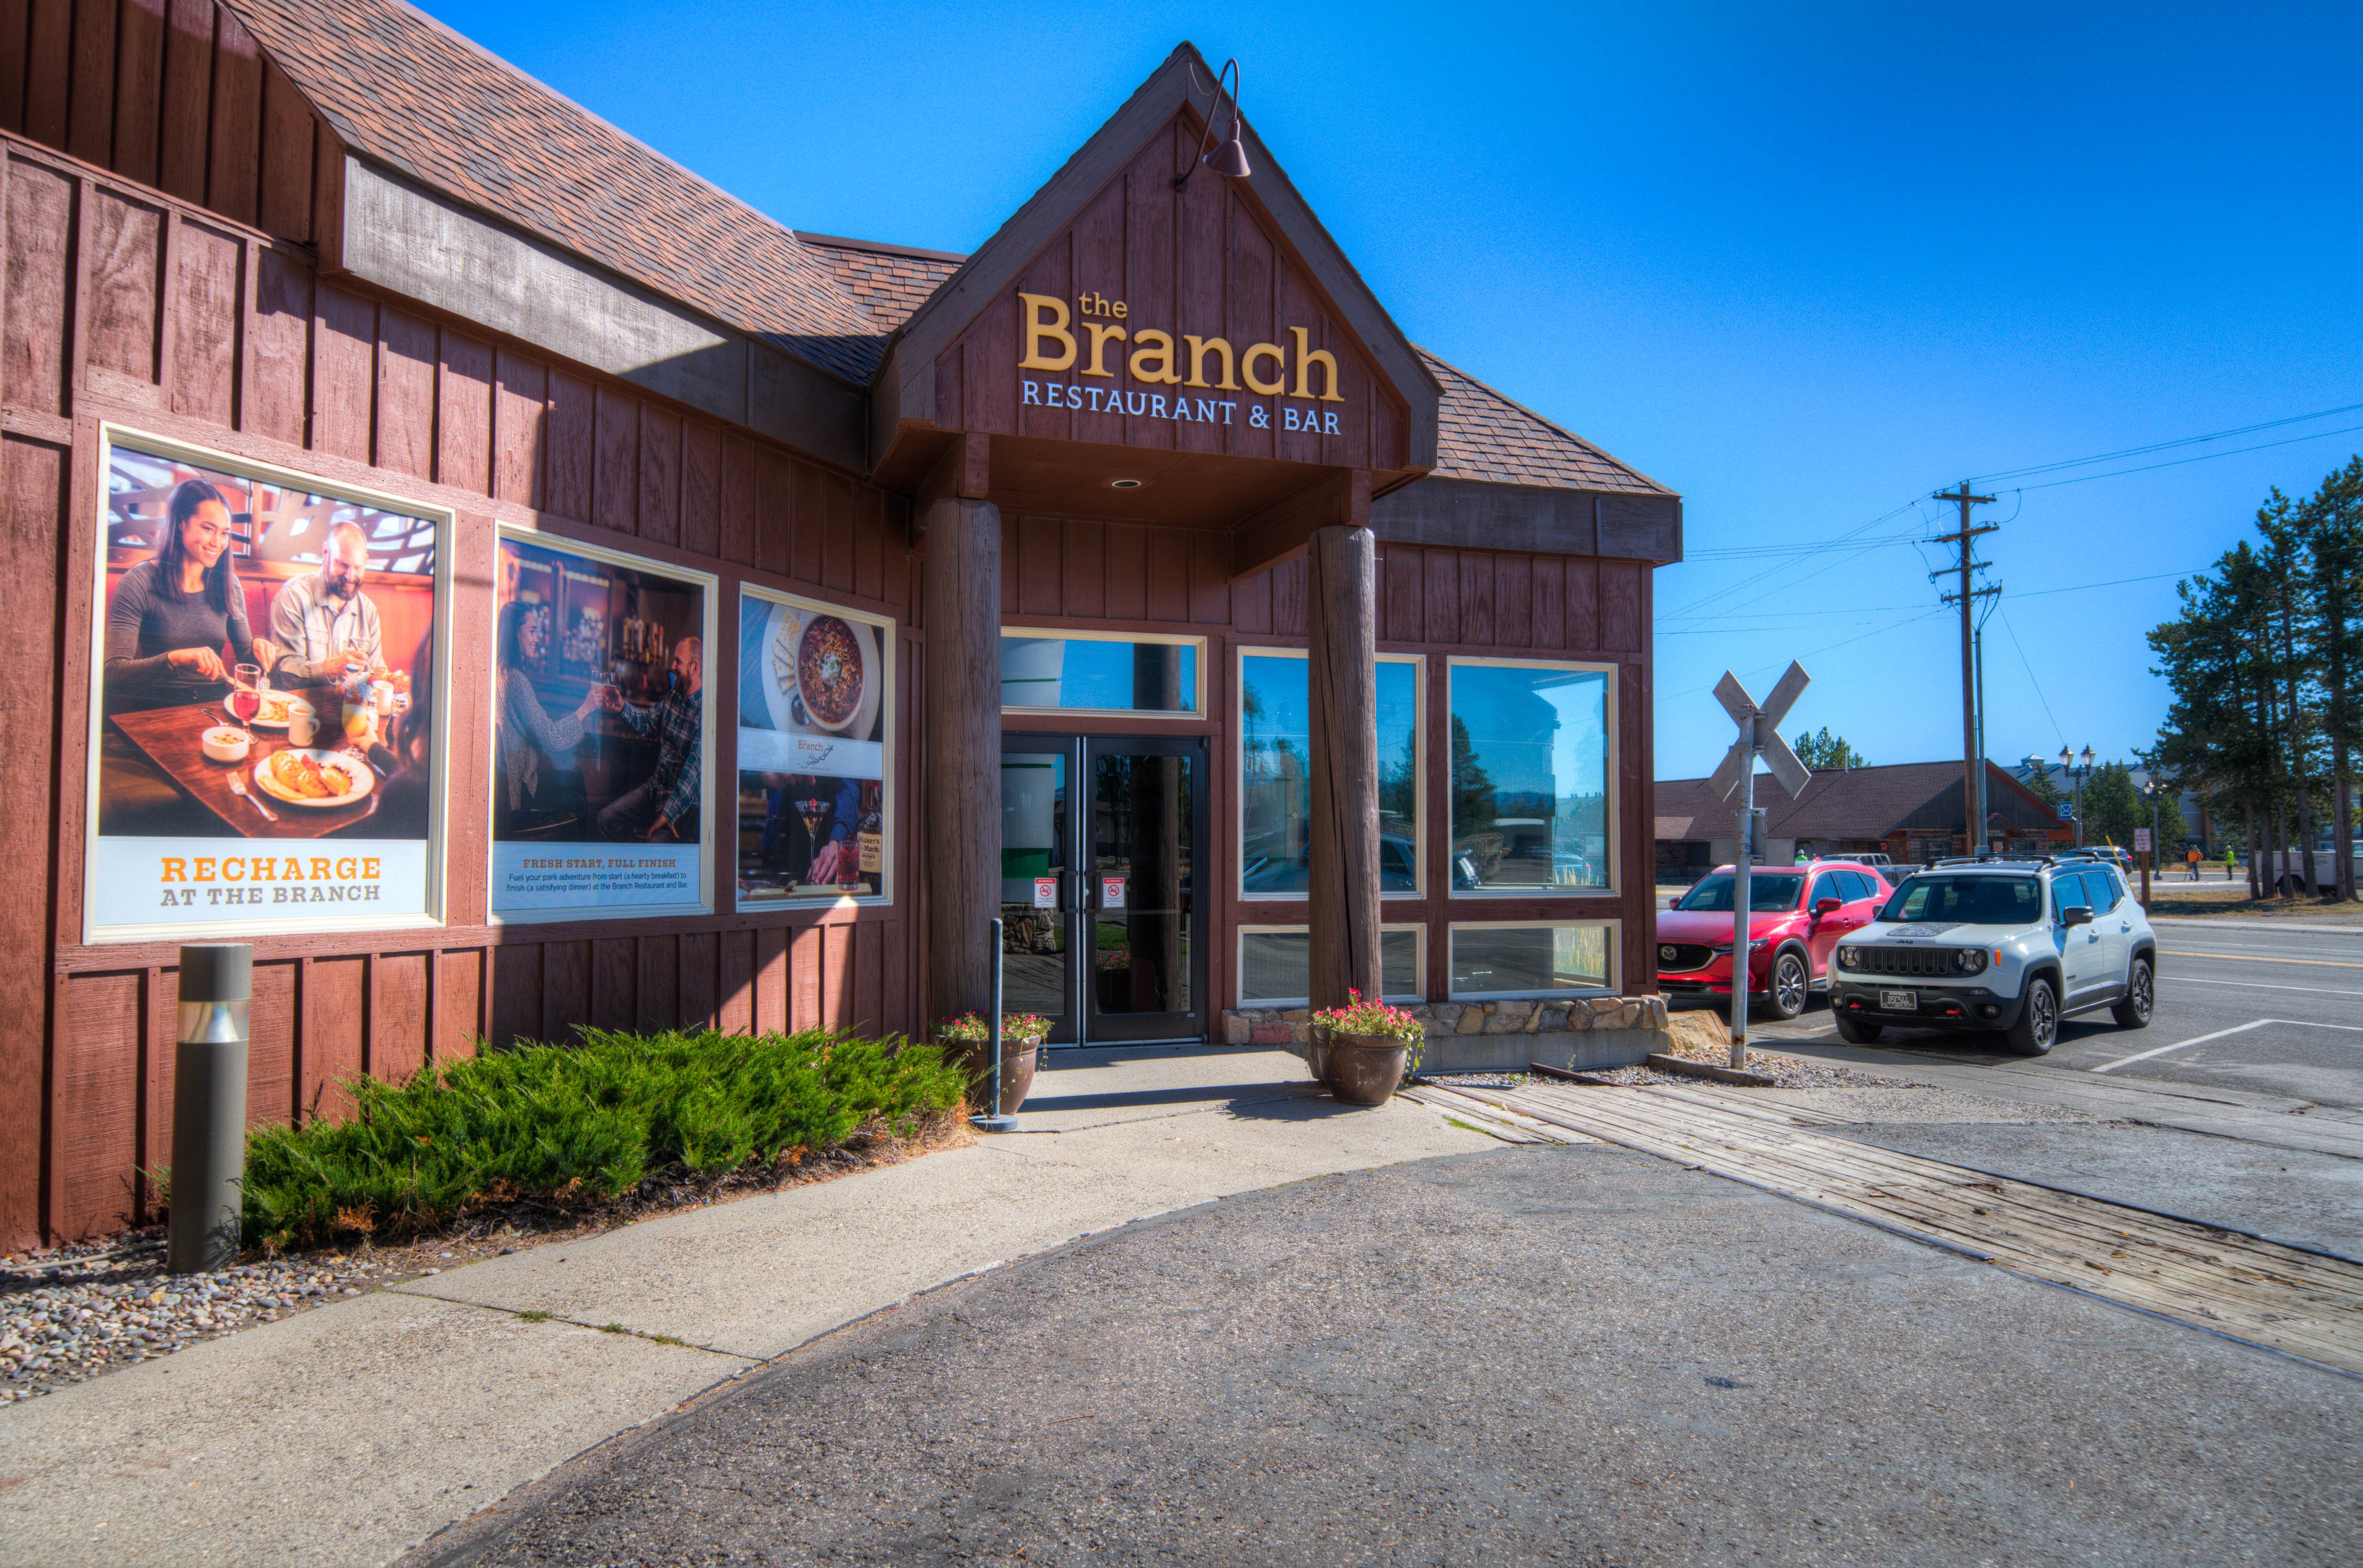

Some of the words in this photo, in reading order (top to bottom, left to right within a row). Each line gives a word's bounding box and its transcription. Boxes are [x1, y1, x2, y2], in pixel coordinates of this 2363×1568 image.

[1079, 291, 1128, 318] the
[1018, 291, 1345, 402] Branch
[1021, 380, 1237, 424] RESTAURANT
[1249, 404, 1271, 429] &
[1283, 407, 1342, 435] BAR
[798, 739, 823, 751] Branch
[160, 857, 381, 882] RECHARGE
[522, 859, 563, 868] FRESH
[566, 859, 604, 869] START,
[608, 859, 635, 867] FULL
[638, 859, 676, 867] FINISH
[160, 889, 196, 906] AT
[206, 887, 263, 905] THE
[272, 885, 380, 903] BRANCH
[535, 883, 567, 892] satisfying
